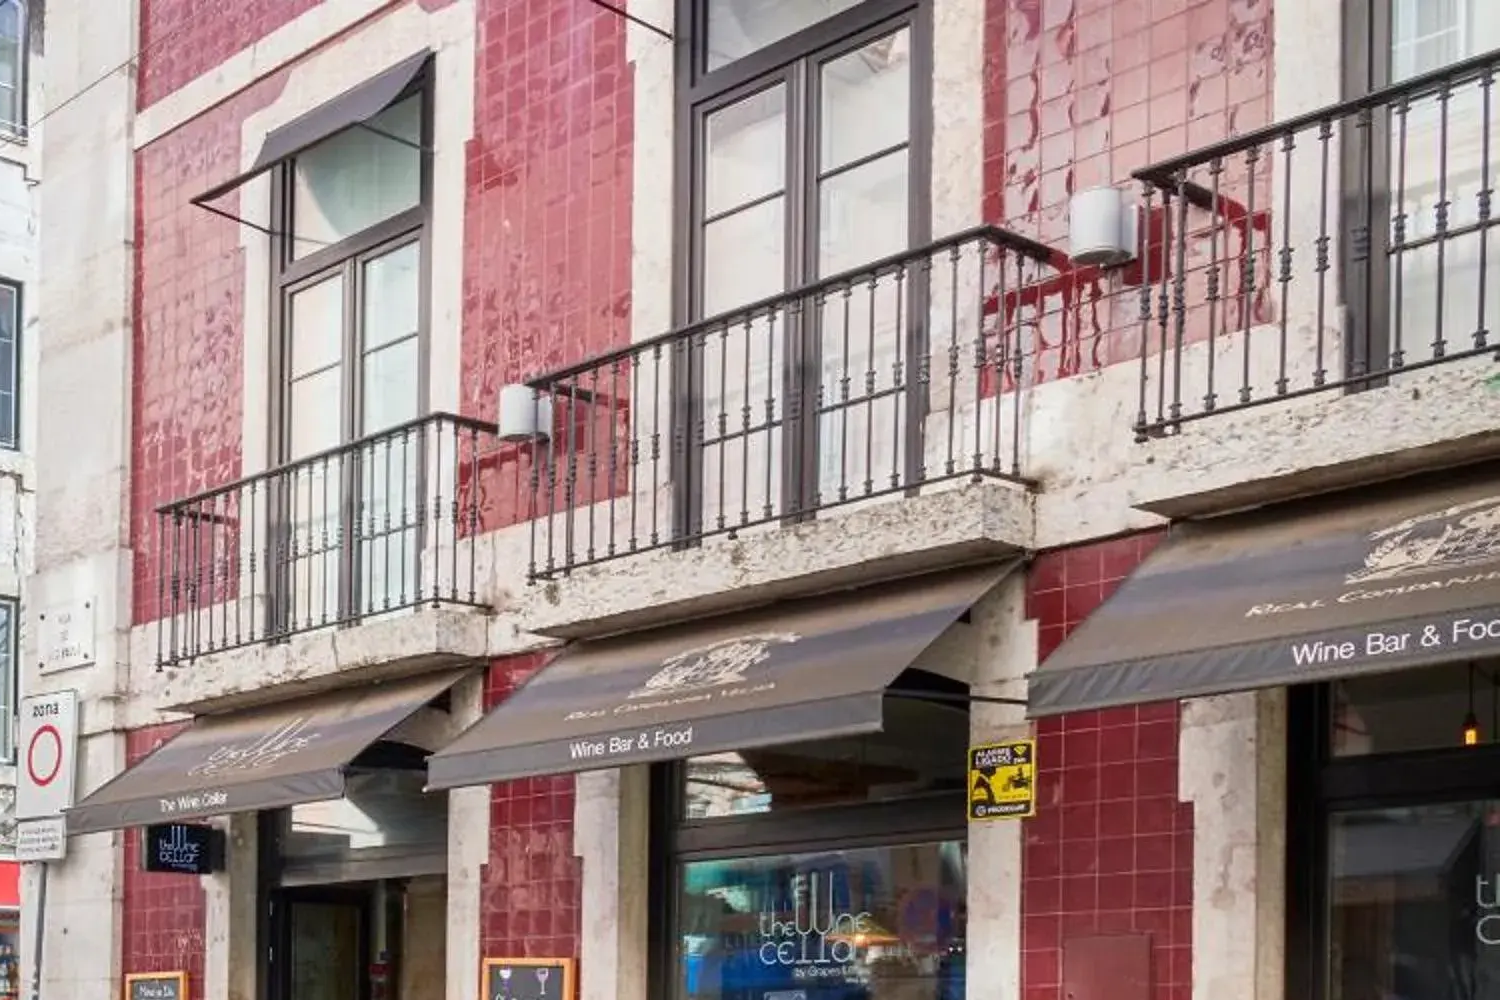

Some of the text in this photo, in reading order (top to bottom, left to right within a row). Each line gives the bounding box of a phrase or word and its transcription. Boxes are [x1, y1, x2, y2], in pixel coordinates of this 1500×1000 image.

[1293, 618, 1500, 665] Wine Bar & Foo
[32, 702, 59, 718] zona
[569, 727, 693, 760] Wine Bar & Food
[160, 790, 229, 813] The Wine Cellar
